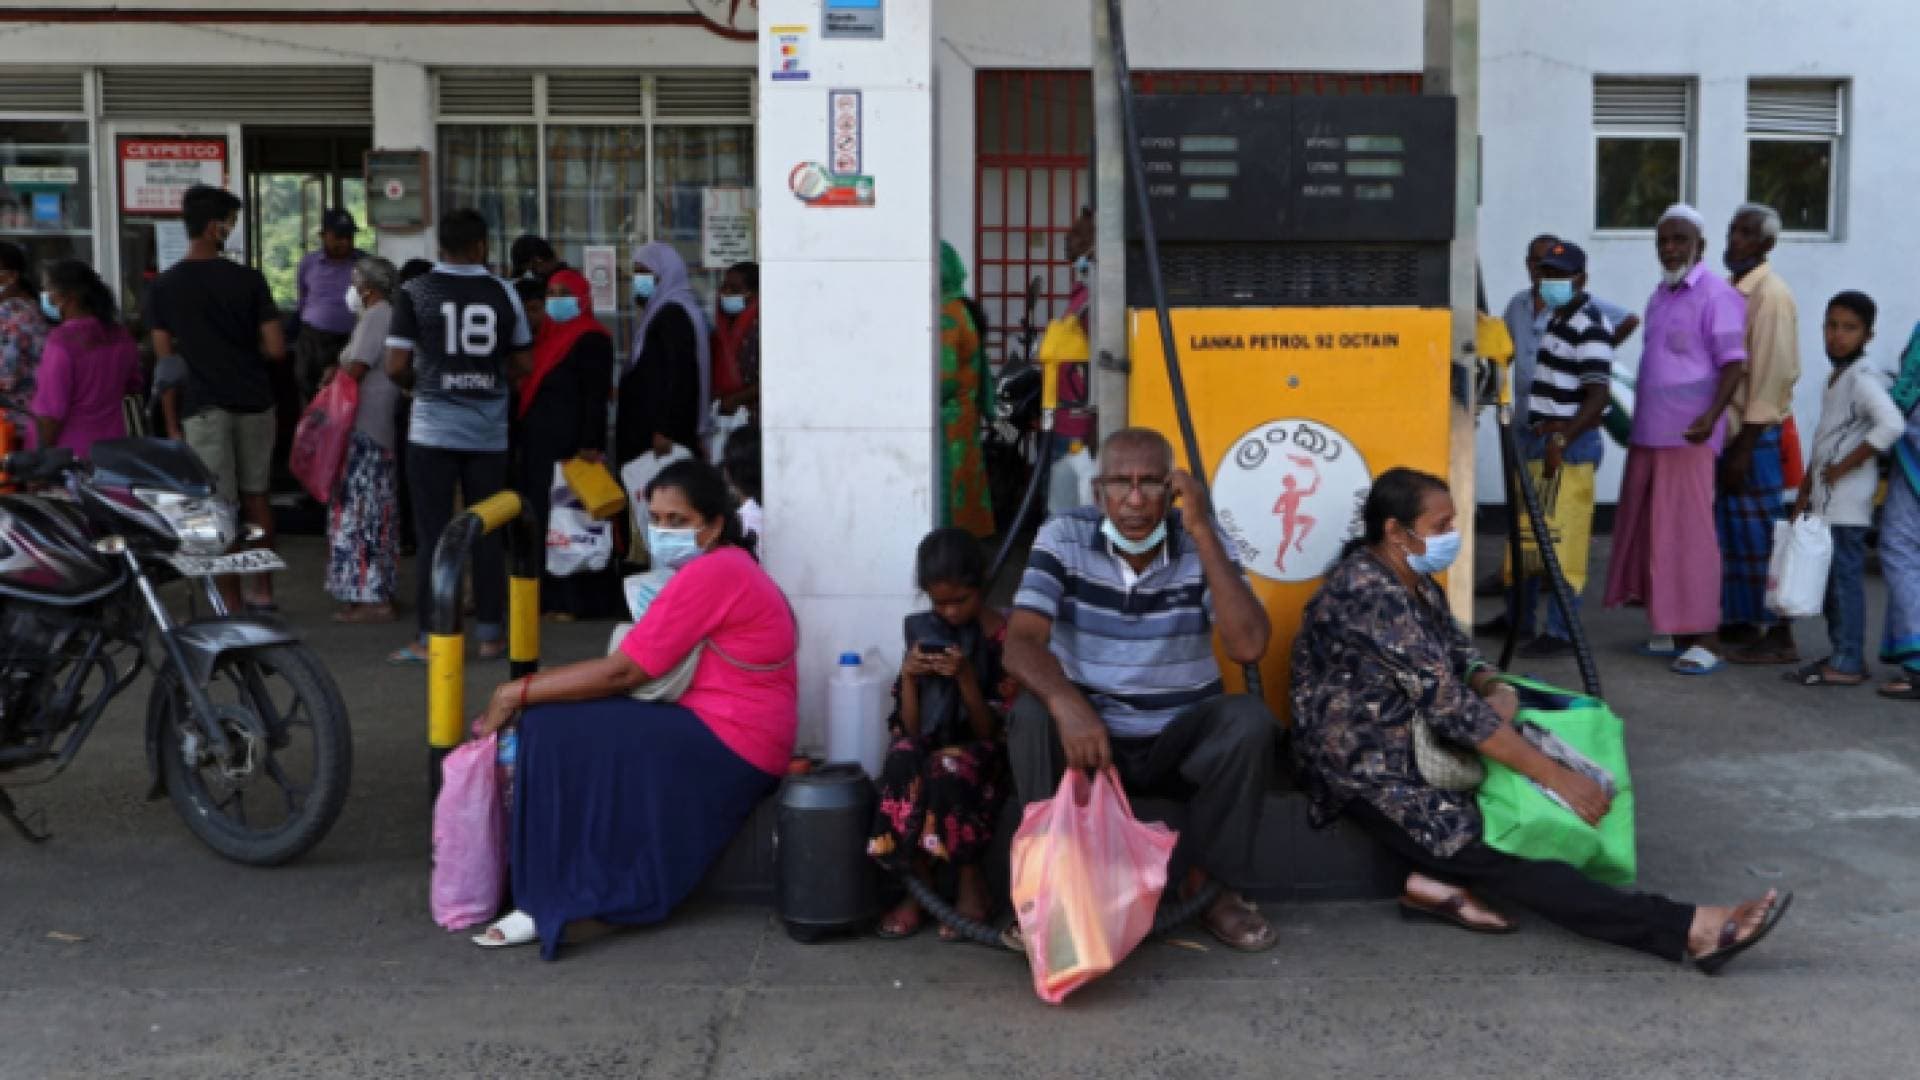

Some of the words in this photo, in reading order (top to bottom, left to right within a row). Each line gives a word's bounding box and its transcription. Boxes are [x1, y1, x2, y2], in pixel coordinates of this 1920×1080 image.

[440, 302, 498, 356] 18
[1191, 335, 1244, 351] LANKA
[1250, 334, 1310, 350] PETROL
[1315, 334, 1334, 349] 92
[1339, 333, 1399, 348] OCTAIN
